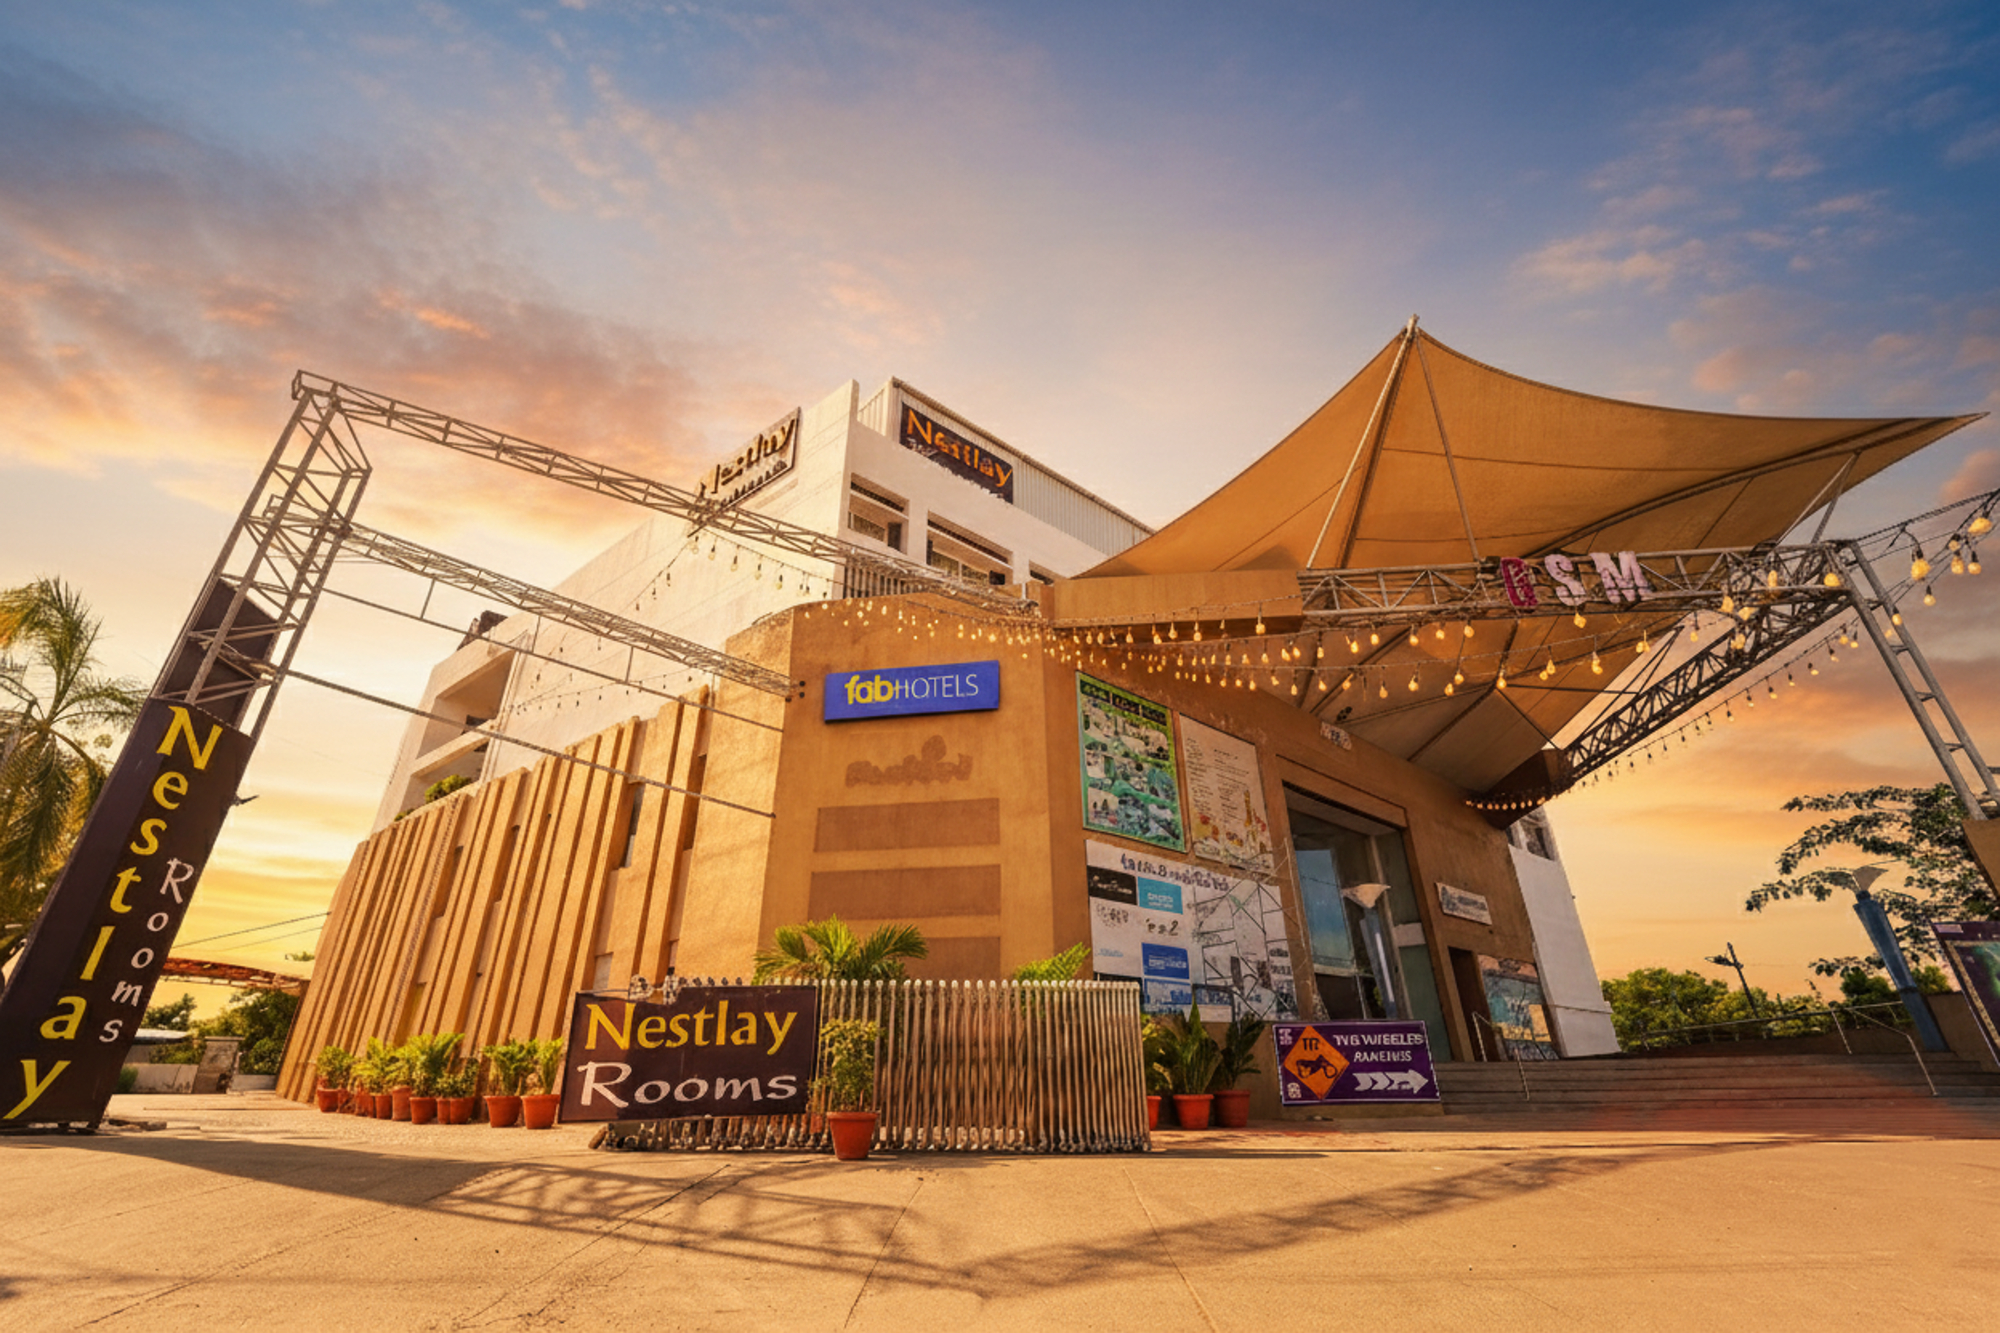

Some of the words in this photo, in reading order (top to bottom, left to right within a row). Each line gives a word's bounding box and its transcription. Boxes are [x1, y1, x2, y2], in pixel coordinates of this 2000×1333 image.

[3, 706, 223, 1120] Nestlay
[100, 857, 195, 1043] Rooms
[577, 1061, 798, 1109] Rooms
[585, 1000, 798, 1055] Nestlay
